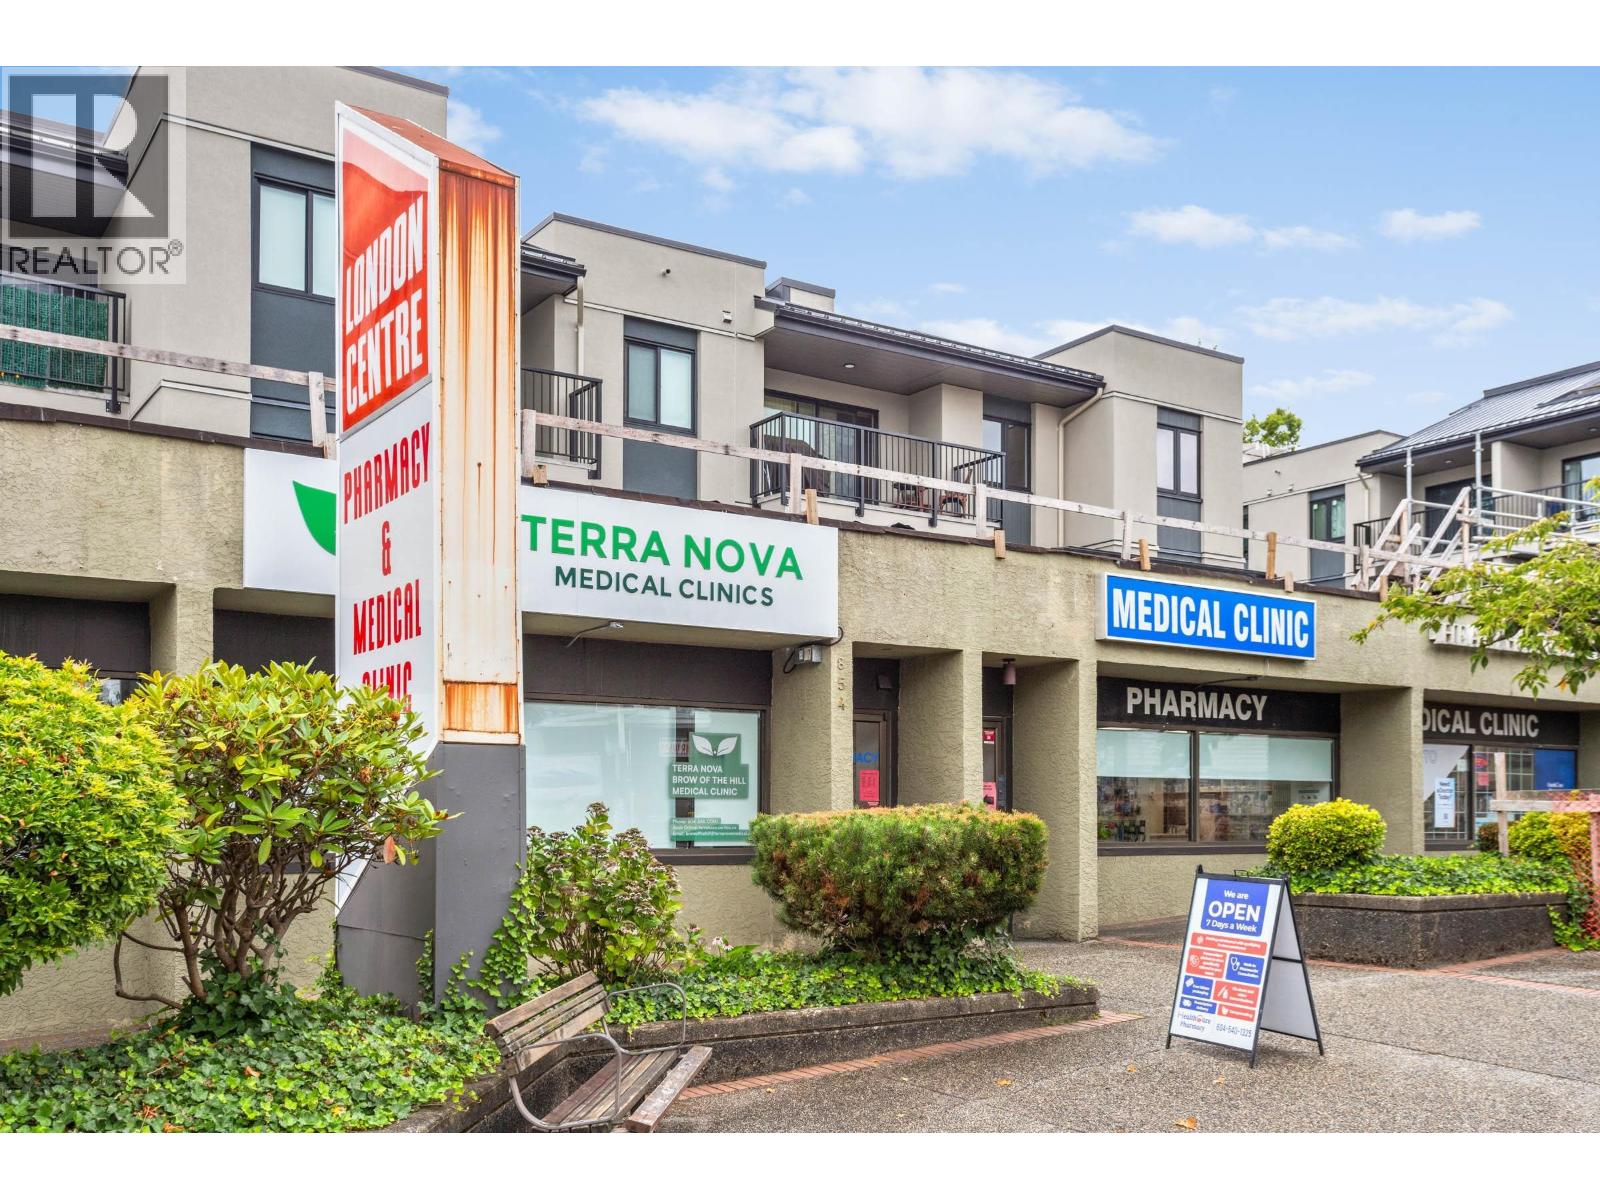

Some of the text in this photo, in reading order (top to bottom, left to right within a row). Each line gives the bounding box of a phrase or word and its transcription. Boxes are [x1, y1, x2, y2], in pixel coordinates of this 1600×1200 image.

[345, 195, 424, 335] LONDON
[345, 288, 424, 416] CENTRE
[343, 421, 430, 525] PHARMACY
[380, 520, 392, 577] &
[521, 514, 804, 581] TERRA NOVA
[554, 565, 774, 607] MEDICAL CLINICS
[352, 579, 422, 655] MEDICAL
[1112, 588, 1309, 648] MEDICAL CLINIC
[1126, 687, 1268, 721] PHARMACY
[1480, 712, 1539, 738] CLINIC
[672, 764, 723, 773] TERRA NOVA
[672, 775, 747, 785] BROW OF THE HILL
[672, 787, 738, 796] MEDICAL CLINIC
[1208, 900, 1261, 923] OPEN
[1224, 889, 1249, 900] We are
[1211, 920, 1229, 930] Days
[1236, 922, 1257, 933] Week
